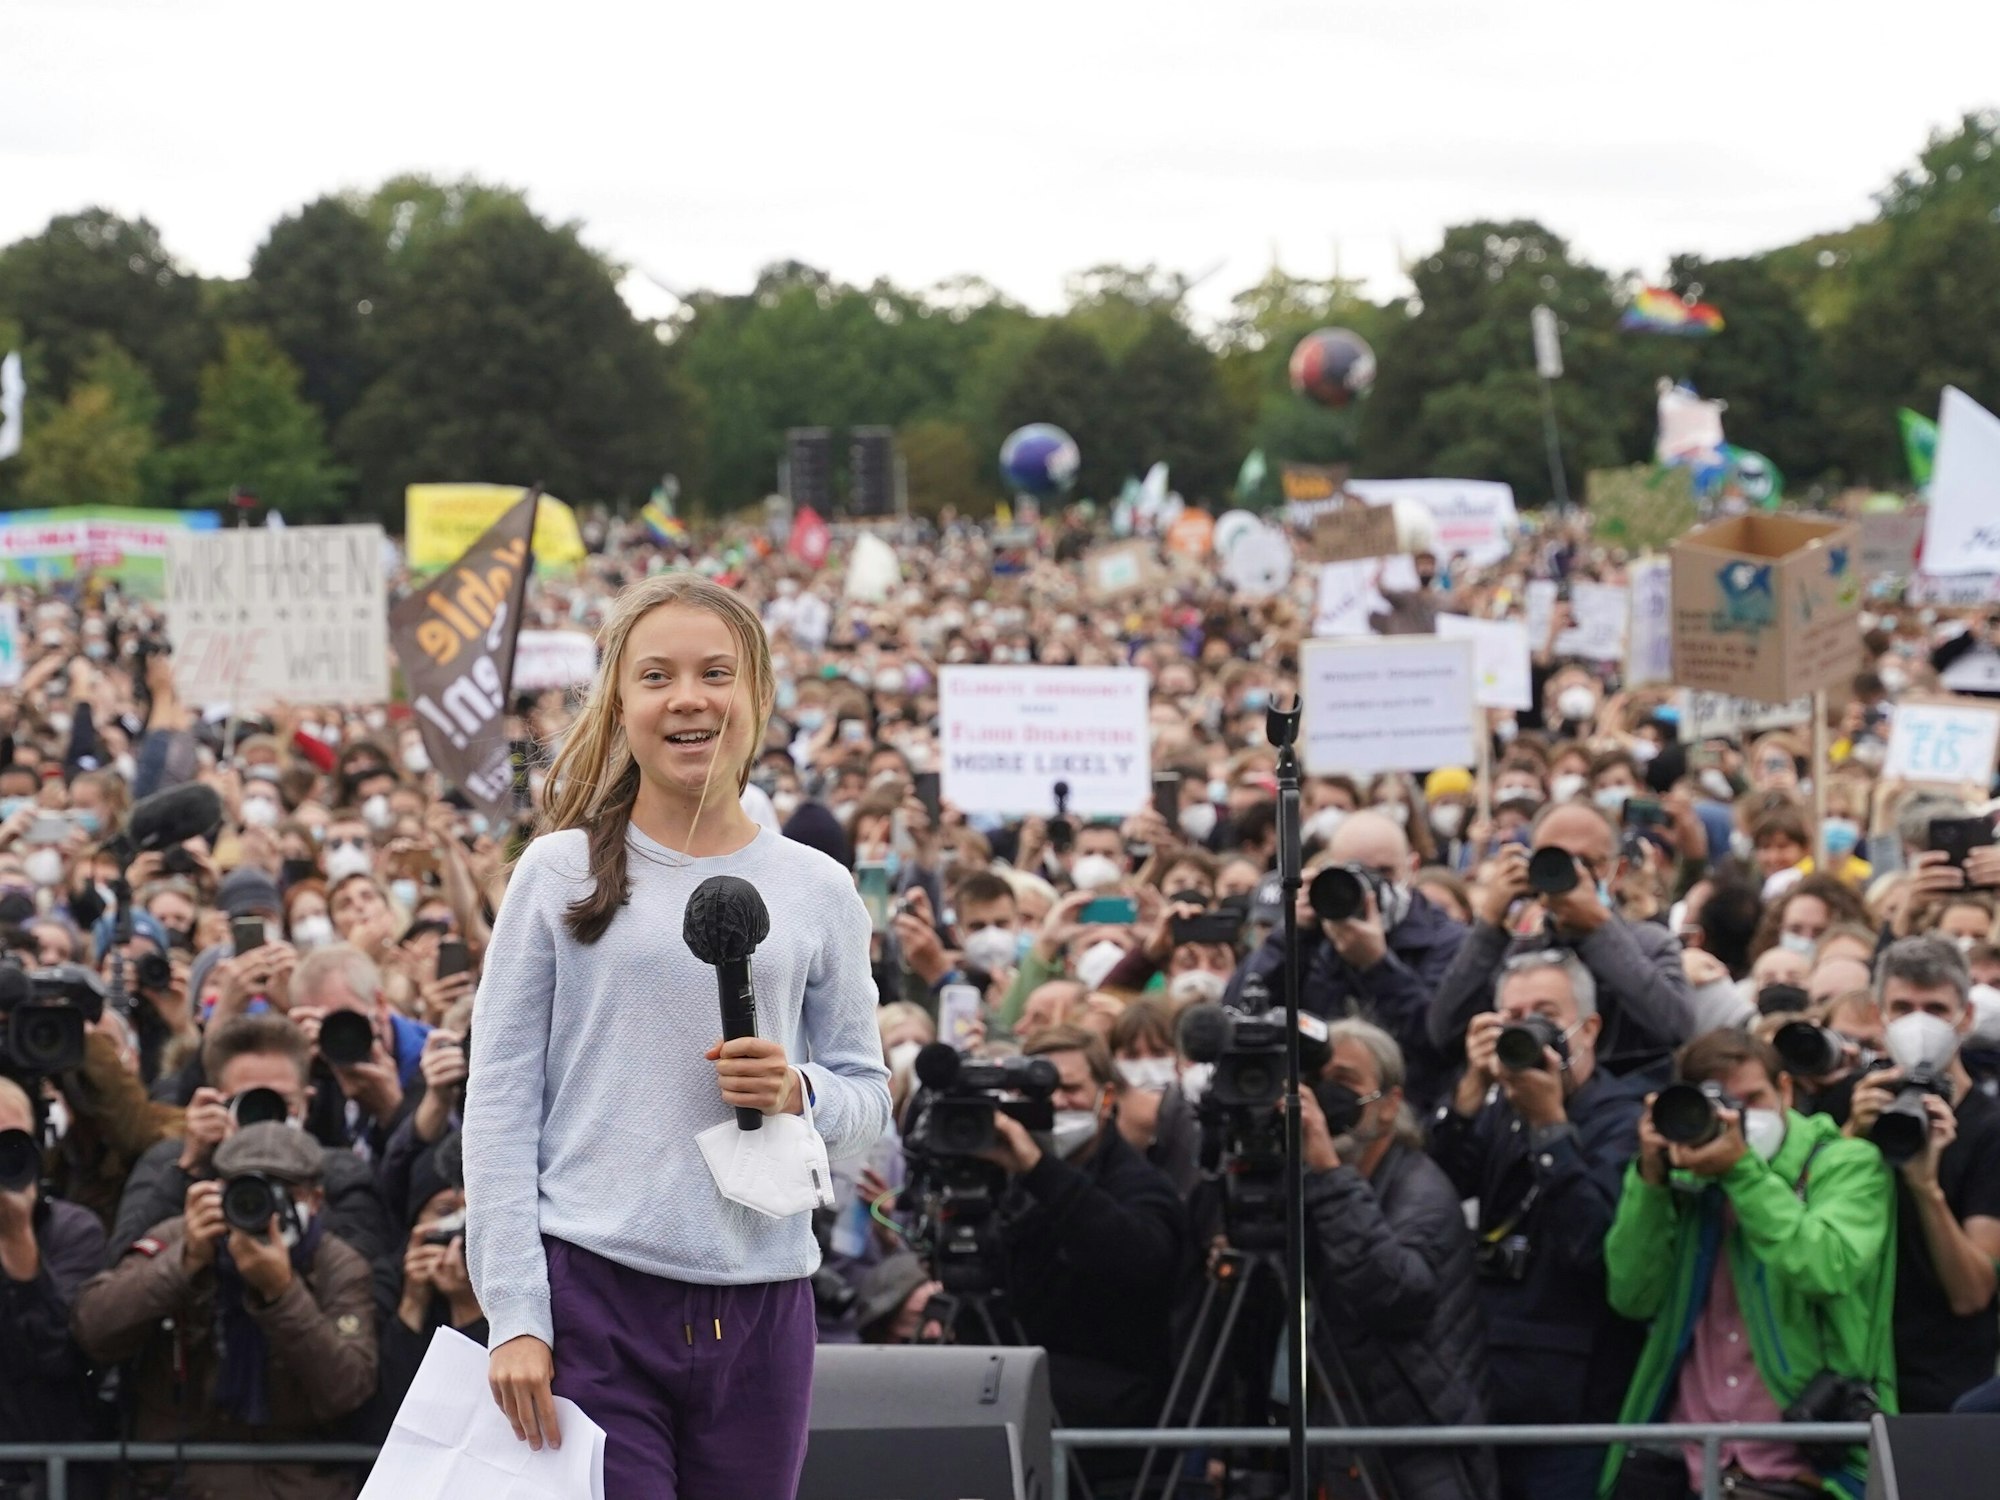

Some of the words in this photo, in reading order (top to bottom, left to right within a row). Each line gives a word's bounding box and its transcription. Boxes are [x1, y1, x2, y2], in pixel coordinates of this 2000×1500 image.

[165, 537, 234, 603] WIR
[243, 533, 378, 601] HABEN
[172, 627, 269, 685] EINE
[952, 753, 1024, 772] MORE
[1032, 753, 1134, 774] LIKELY
